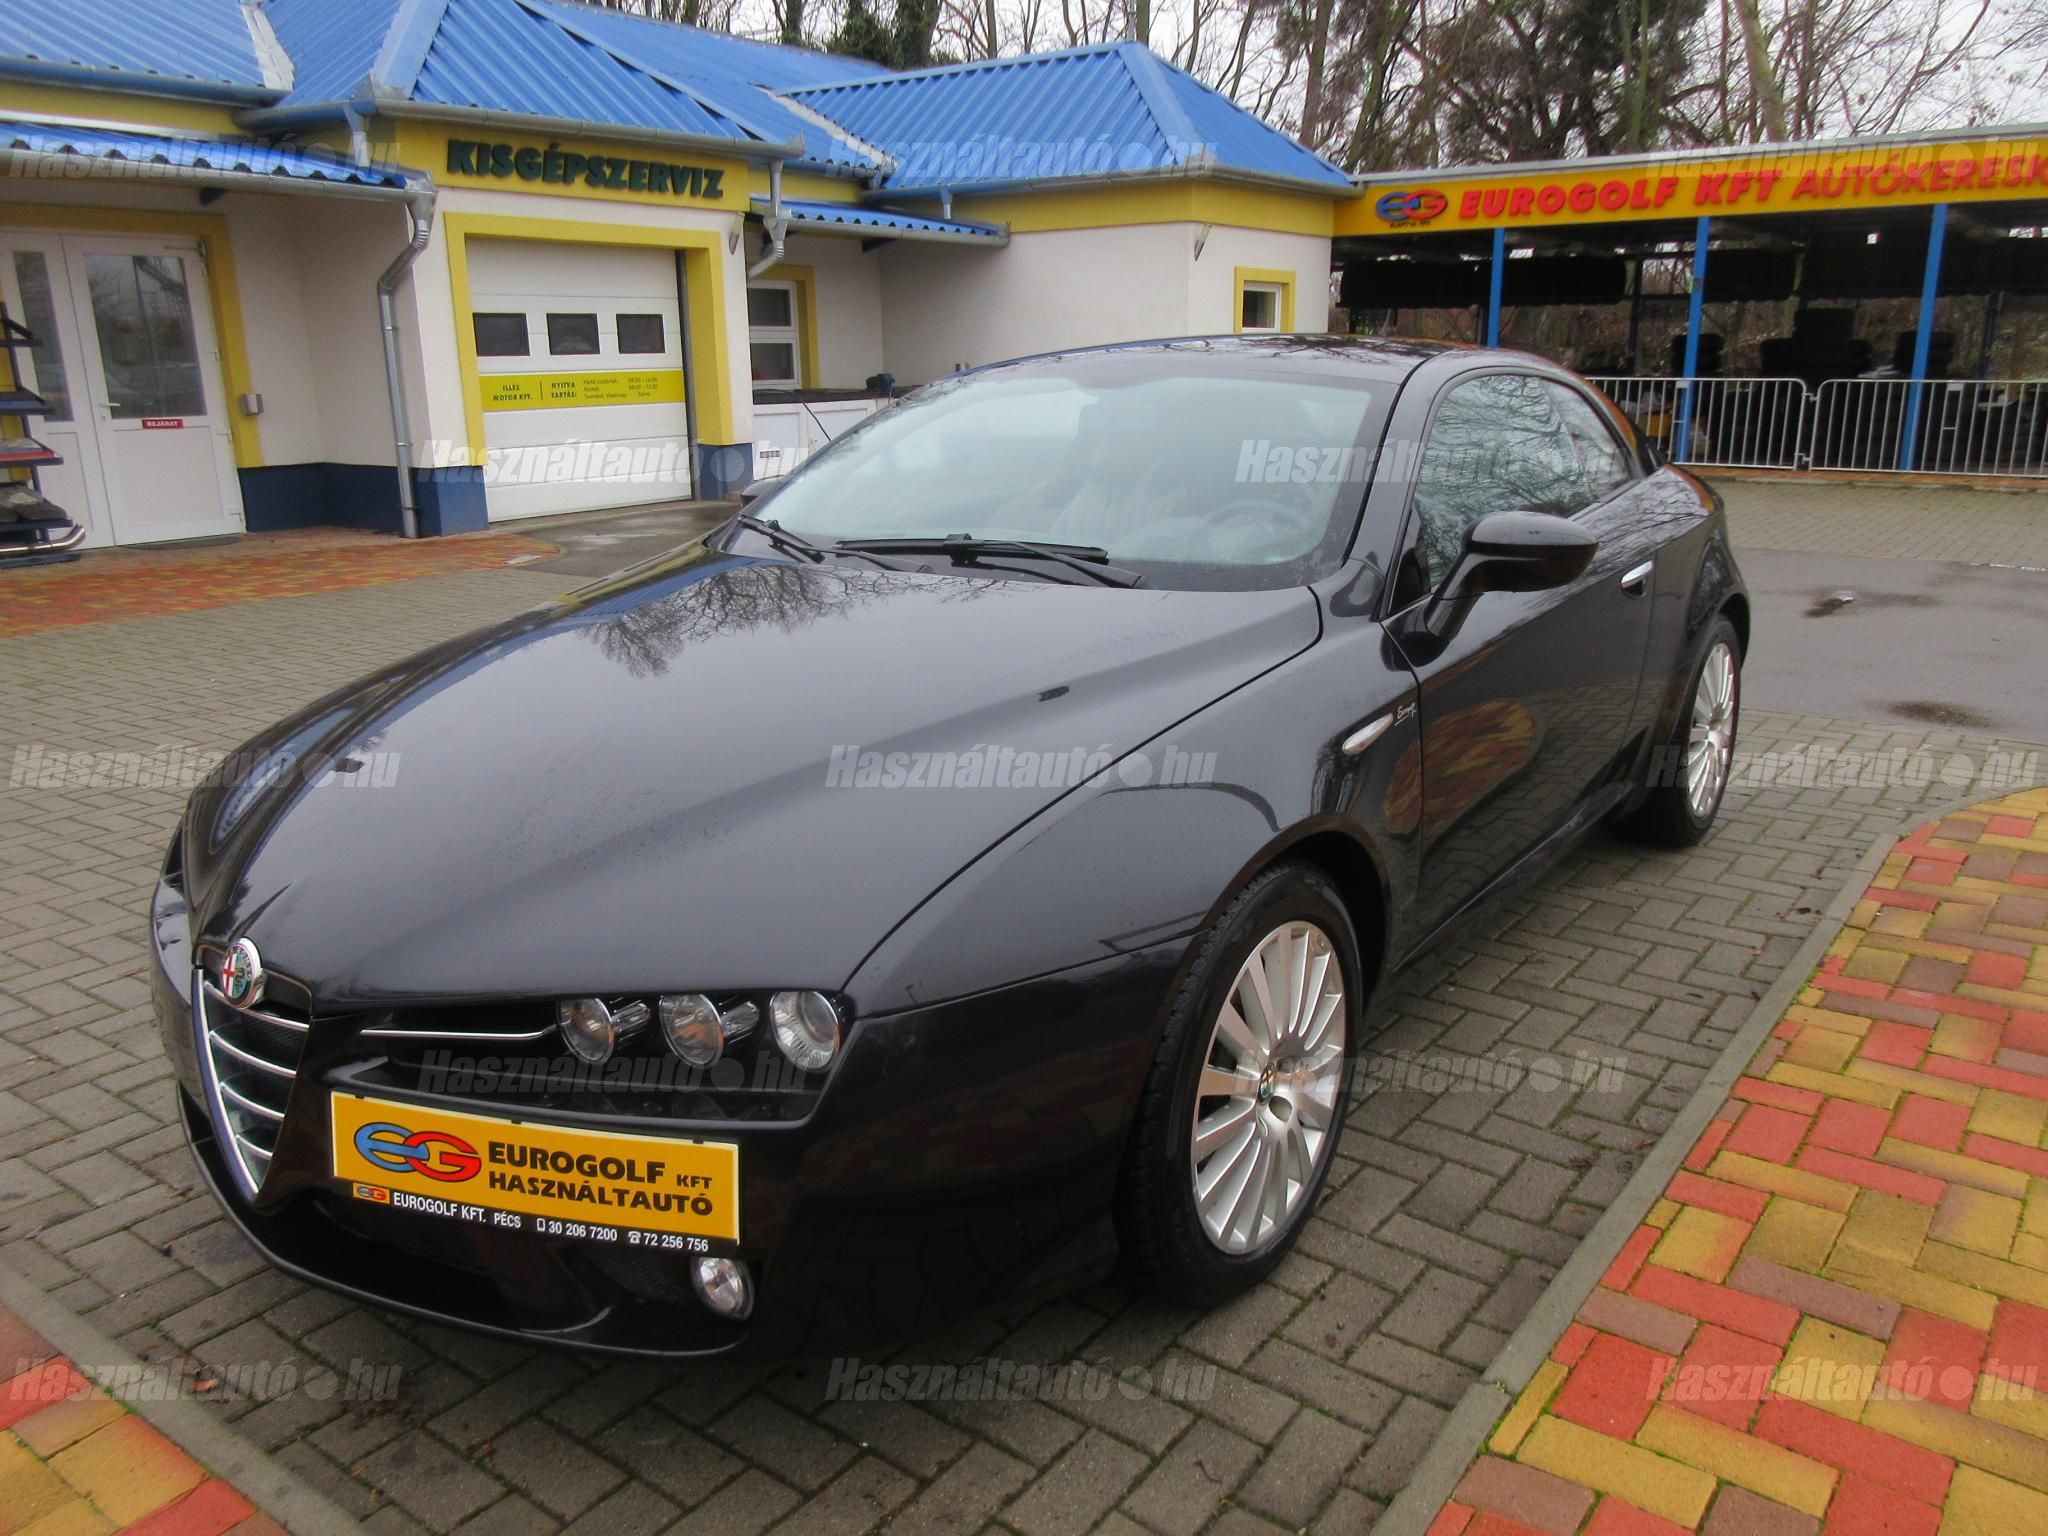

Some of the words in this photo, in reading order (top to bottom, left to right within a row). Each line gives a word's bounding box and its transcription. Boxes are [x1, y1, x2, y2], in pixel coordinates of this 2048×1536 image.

[446, 140, 725, 199] KISGÉPSZERVIZ
[1458, 176, 1679, 219] EUROGOLF
[1694, 169, 1780, 206] KFT
[488, 1141, 665, 1184] EUROGOLF
[676, 1174, 712, 1190] KFT
[489, 1171, 713, 1216] HASZNÁLTAUTÓ
[393, 1192, 458, 1216] EUROGOLF
[461, 1205, 487, 1223] KFT.
[493, 1211, 522, 1228] PÉCS
[548, 1221, 562, 1235] 30
[566, 1223, 586, 1237] 206
[590, 1225, 618, 1241] 7200
[643, 1232, 658, 1247] 72
[662, 1235, 683, 1249] 256
[687, 1237, 709, 1251] 756
